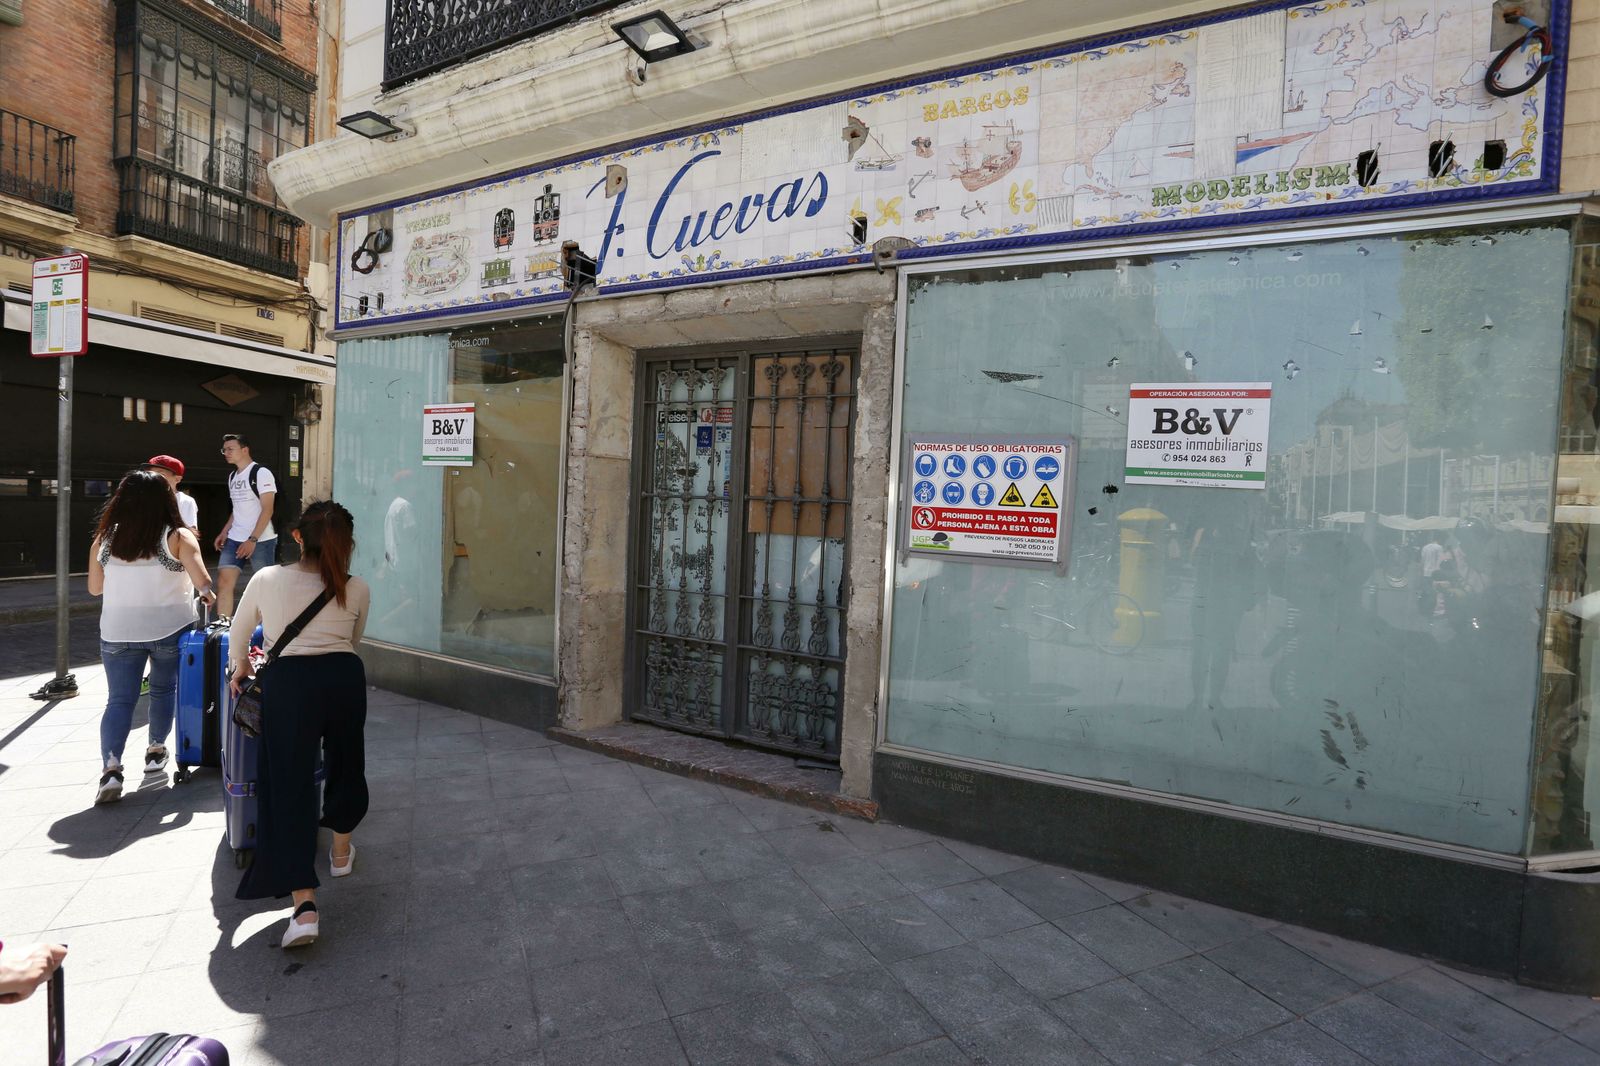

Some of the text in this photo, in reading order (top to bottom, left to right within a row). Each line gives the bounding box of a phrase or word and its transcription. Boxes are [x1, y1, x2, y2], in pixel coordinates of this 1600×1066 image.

[923, 86, 1029, 122] BARCOS
[1152, 161, 1354, 207] MODELISM
[646, 150, 828, 260] Cuevas
[53, 281, 63, 292] C5
[1062, 269, 1342, 299] www.jugueteatecnica.com
[659, 411, 690, 422] Peise
[432, 419, 465, 435] B&V
[914, 444, 953, 452] NORMAS
[991, 445, 1062, 453] OBLIGATORIAS
[1130, 437, 1263, 452] asesores inmobiliarios
[1172, 454, 1226, 463] 954 024 863
[1143, 470, 1244, 479] www.asesoresinmobiliariosbv.es
[942, 512, 983, 521] PROHIBIDO
[985, 513, 995, 521] EL
[997, 514, 1018, 522] PASO
[1028, 515, 1050, 524] TODA
[937, 520, 972, 529] PERSONA
[974, 522, 1000, 531] AJENA
[1009, 524, 1029, 532] ESTA
[1031, 525, 1054, 534] OBRA
[912, 535, 931, 543] UGP
